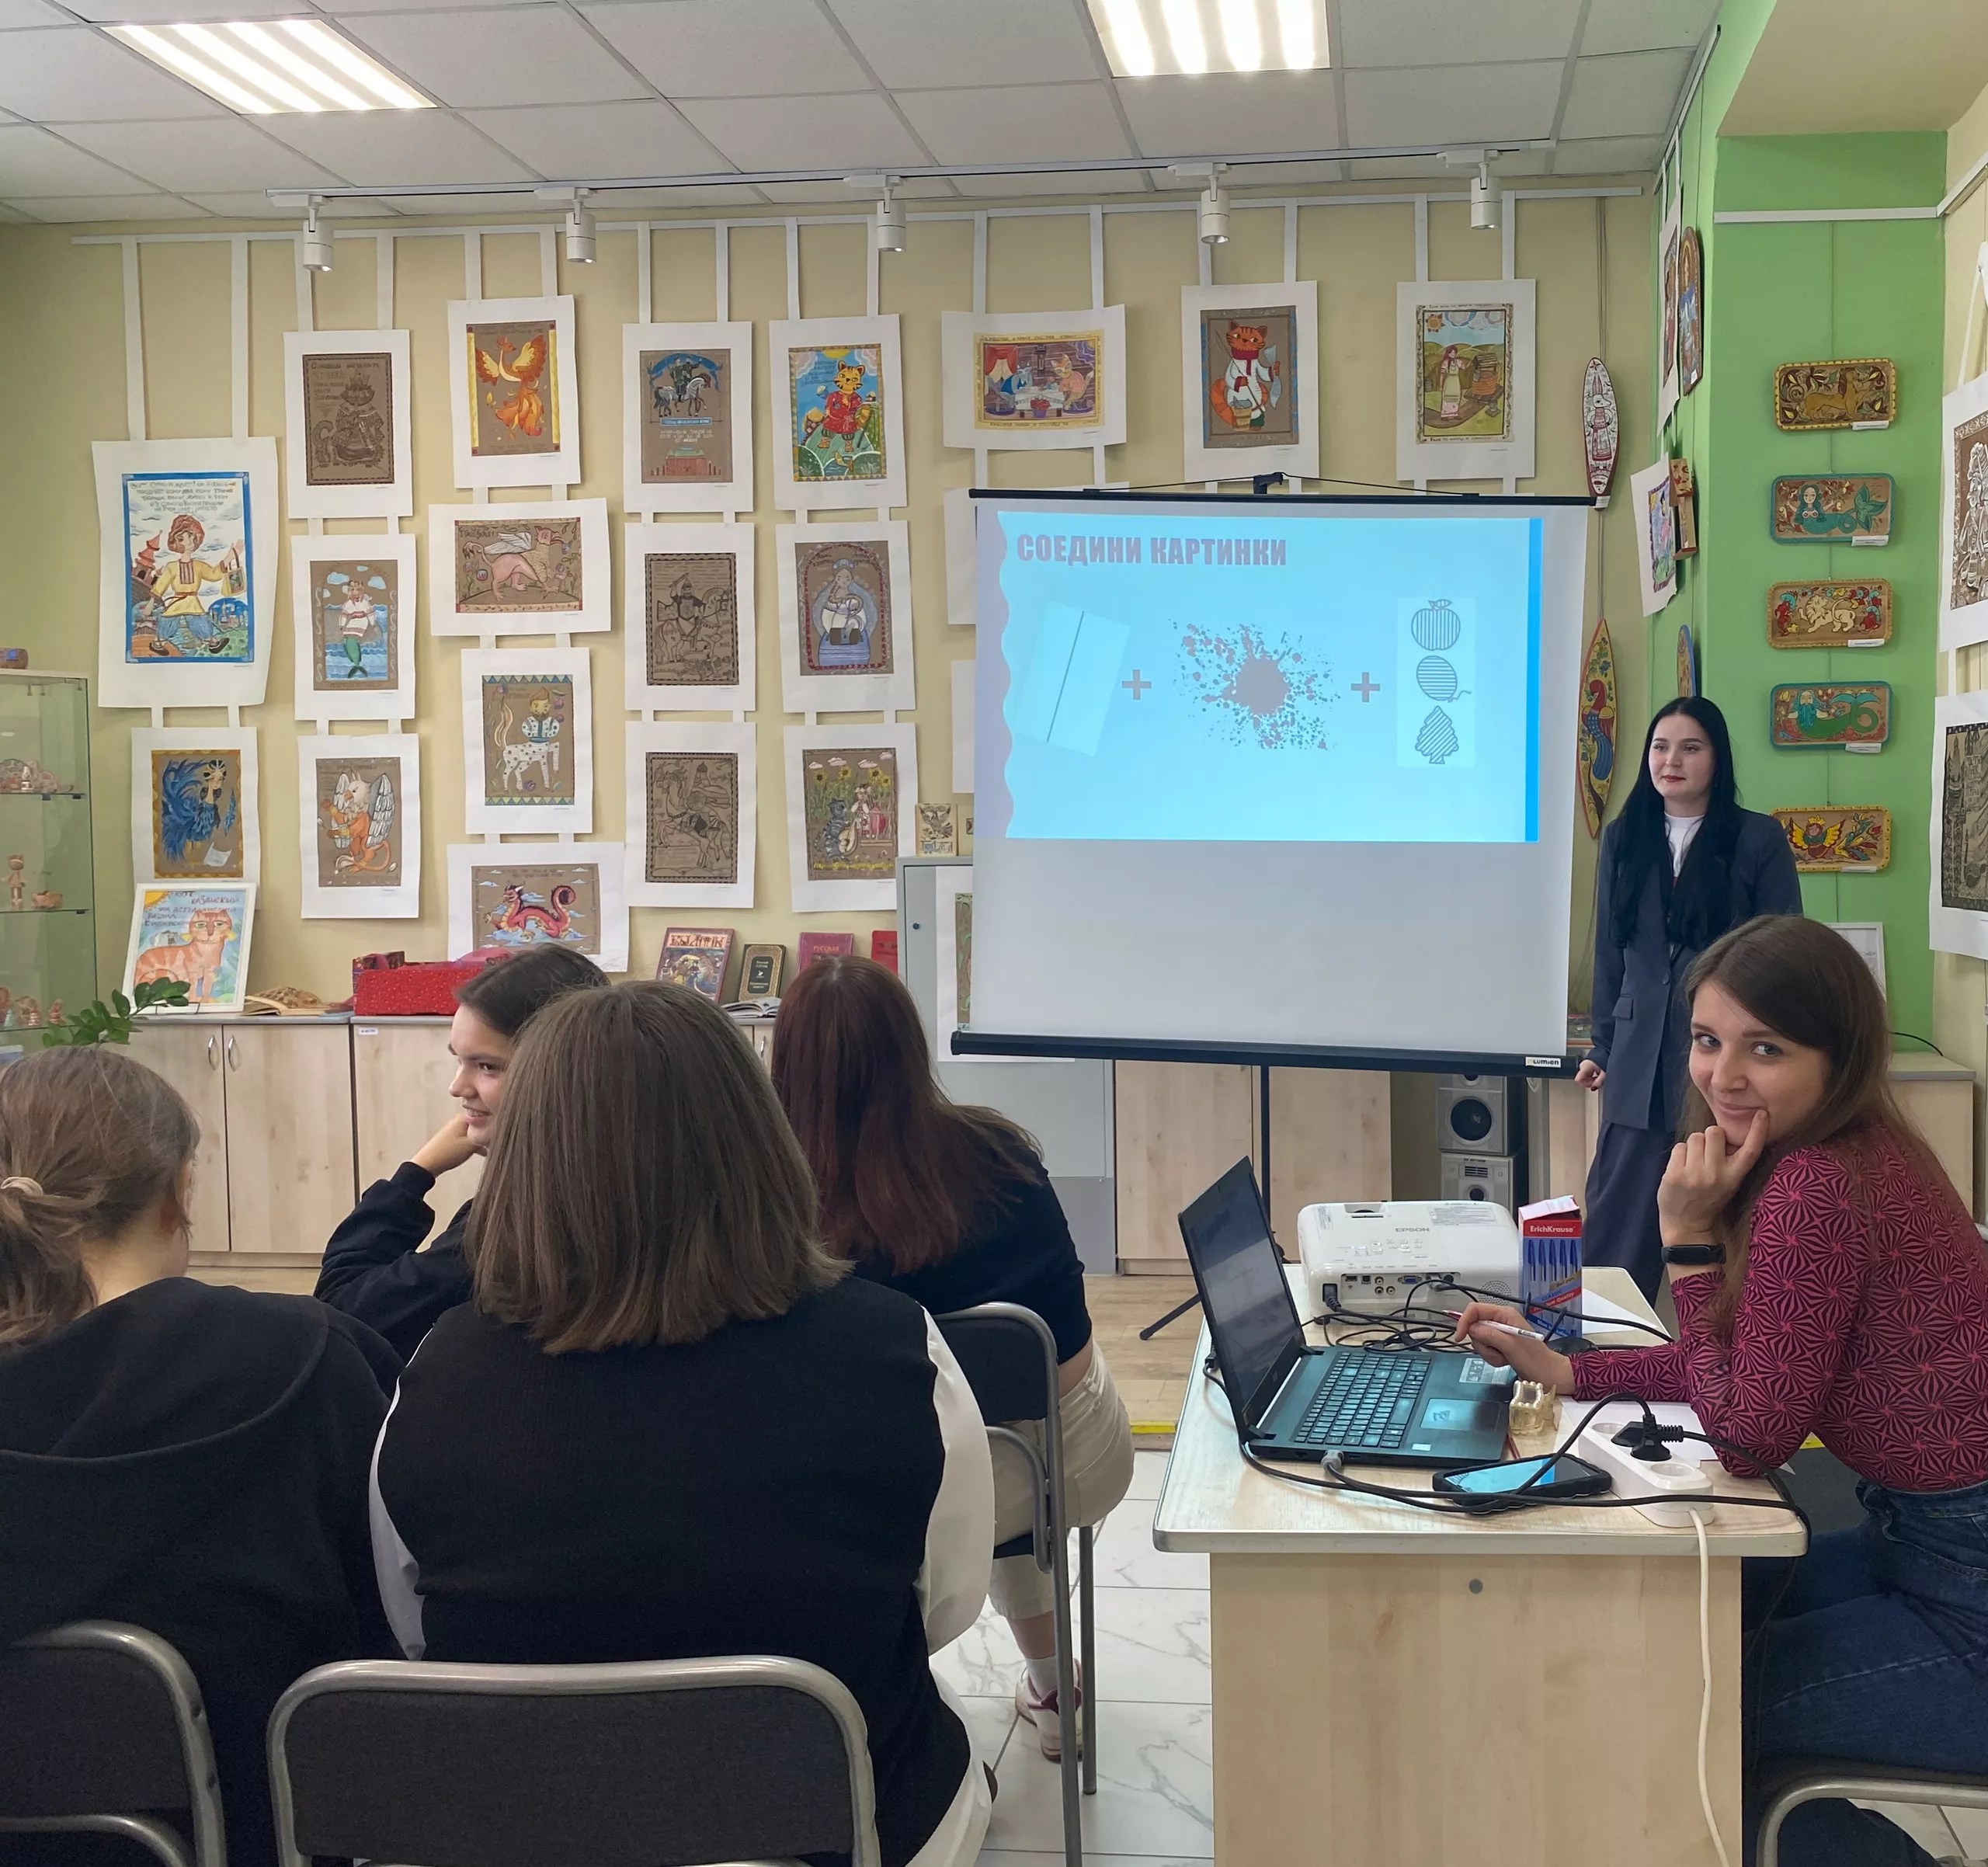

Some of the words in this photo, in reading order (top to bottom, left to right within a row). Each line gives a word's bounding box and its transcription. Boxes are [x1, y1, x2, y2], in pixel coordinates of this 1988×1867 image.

[1017, 534, 1142, 566] СОЕДИНИ
[1150, 537, 1287, 566] КАРТИНКИ
[1530, 1225, 1574, 1233] ErichKrause
[1556, 1292, 1575, 1302] Quality
